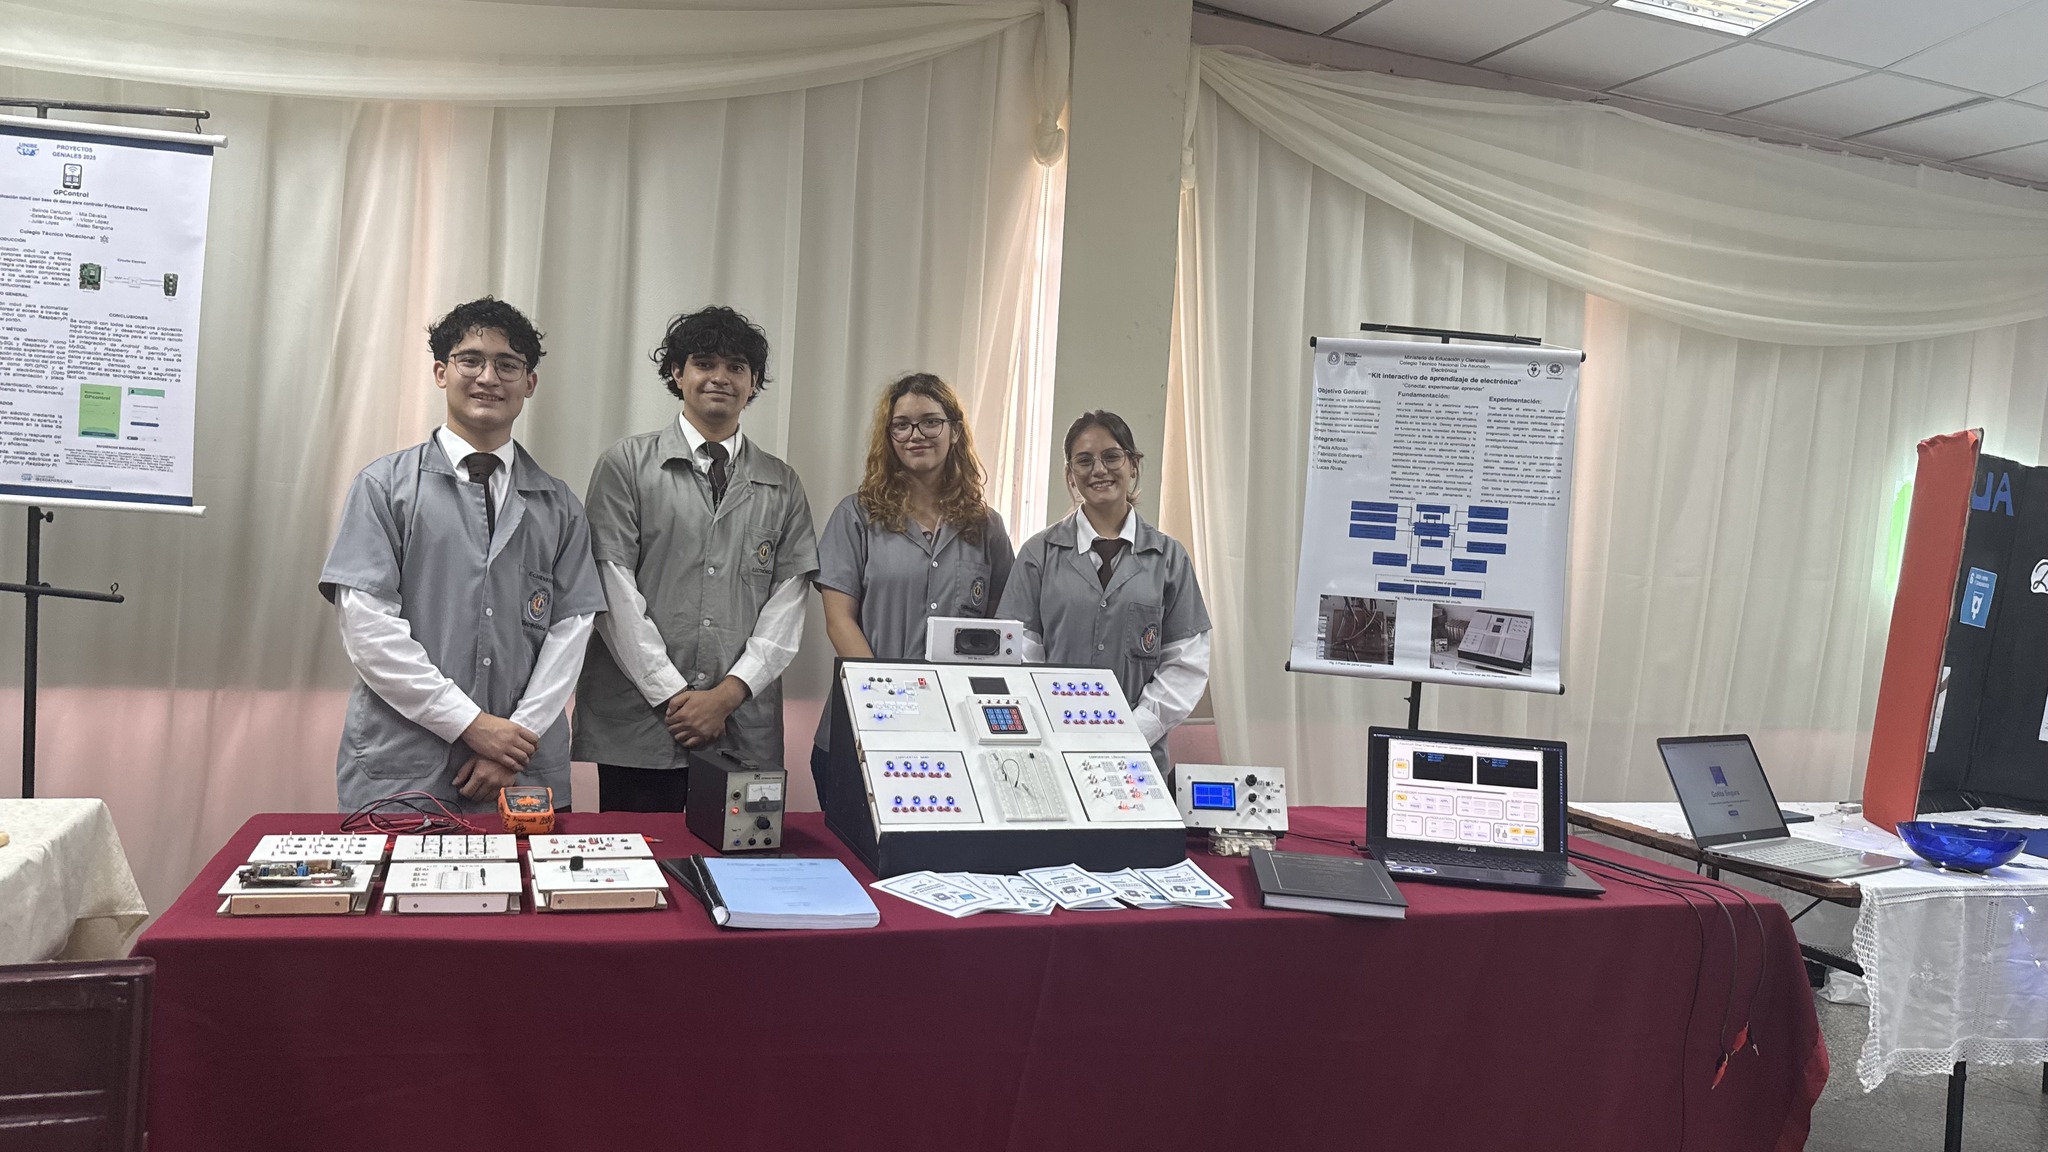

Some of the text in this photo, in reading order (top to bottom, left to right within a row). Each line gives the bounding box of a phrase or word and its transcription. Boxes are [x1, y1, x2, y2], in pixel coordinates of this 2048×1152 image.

[56, 144, 93, 153] PROYECTOS
[52, 151, 82, 160] GENIALES
[53, 189, 89, 198] GPControl
[1430, 376, 1468, 384] aprendizaje
[1318, 387, 1342, 395] Objetivo
